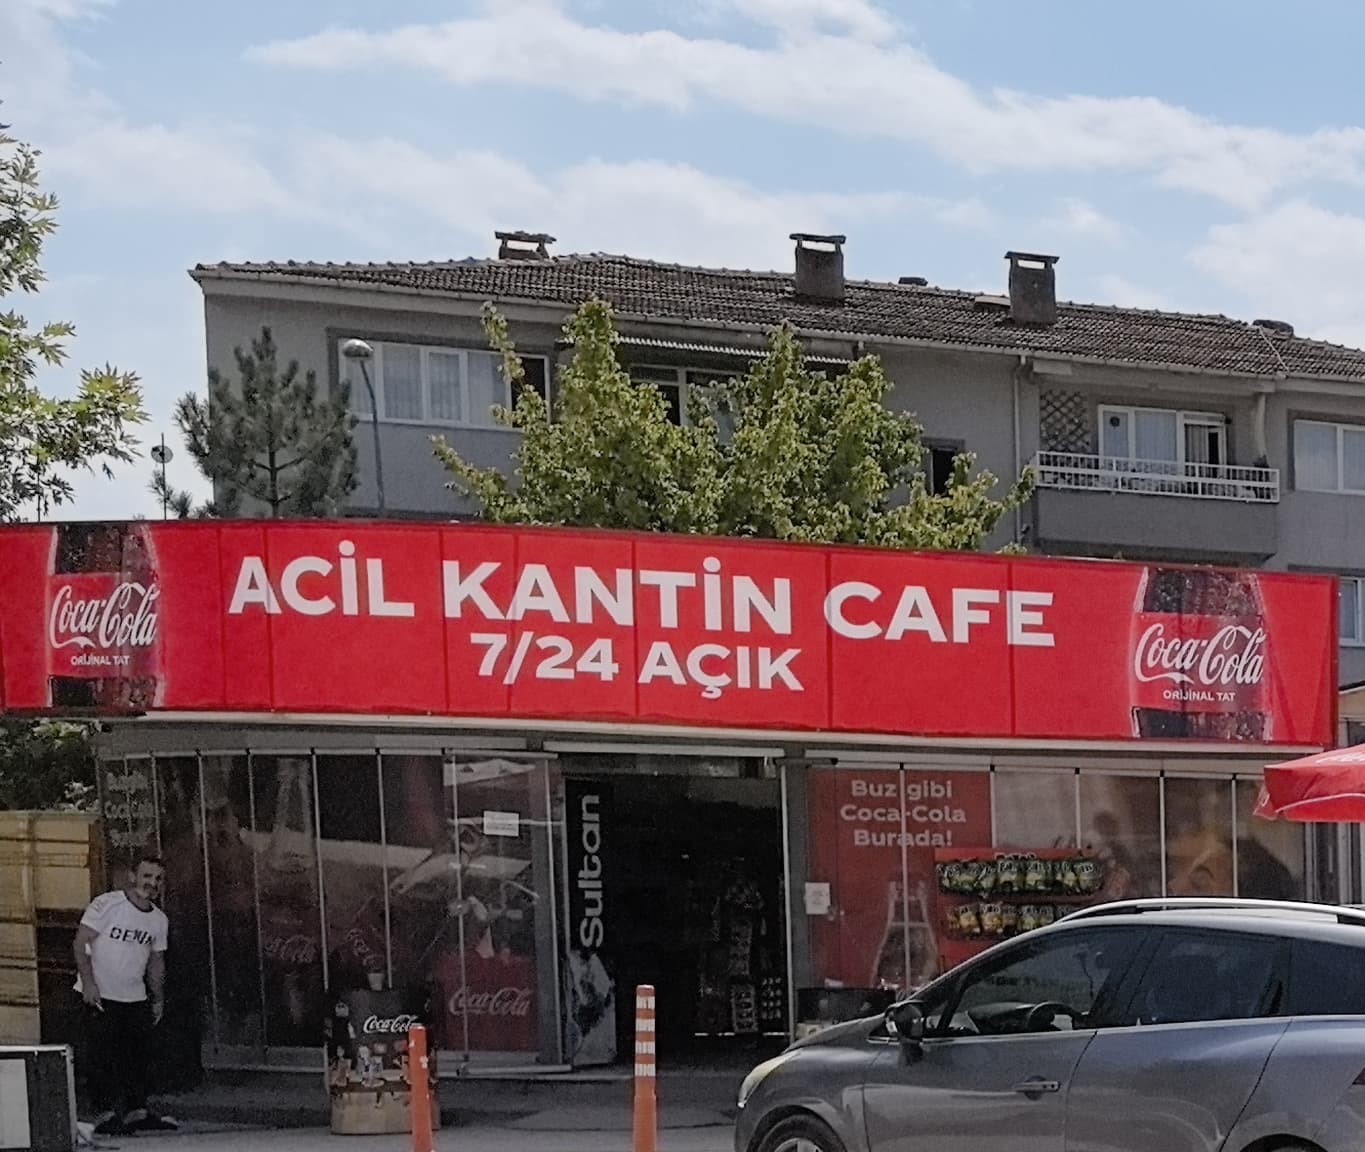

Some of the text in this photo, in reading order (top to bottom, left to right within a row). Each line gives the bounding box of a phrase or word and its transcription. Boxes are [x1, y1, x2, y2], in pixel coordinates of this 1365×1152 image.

[228, 540, 1055, 647] ACİL KANTİN CAFE
[49, 582, 160, 648] Coca-Cola
[112, 655, 130, 665] TAT
[1134, 623, 1267, 685] Coca-Cola
[470, 631, 804, 699] 7/24 AÇIK
[1216, 691, 1236, 702] TAT
[851, 780, 952, 800] Buz gibi
[840, 804, 967, 823] Coca-Cola
[853, 829, 953, 846] Burada!
[578, 794, 604, 948] Sultan
[363, 1014, 418, 1033] Coca-Col
